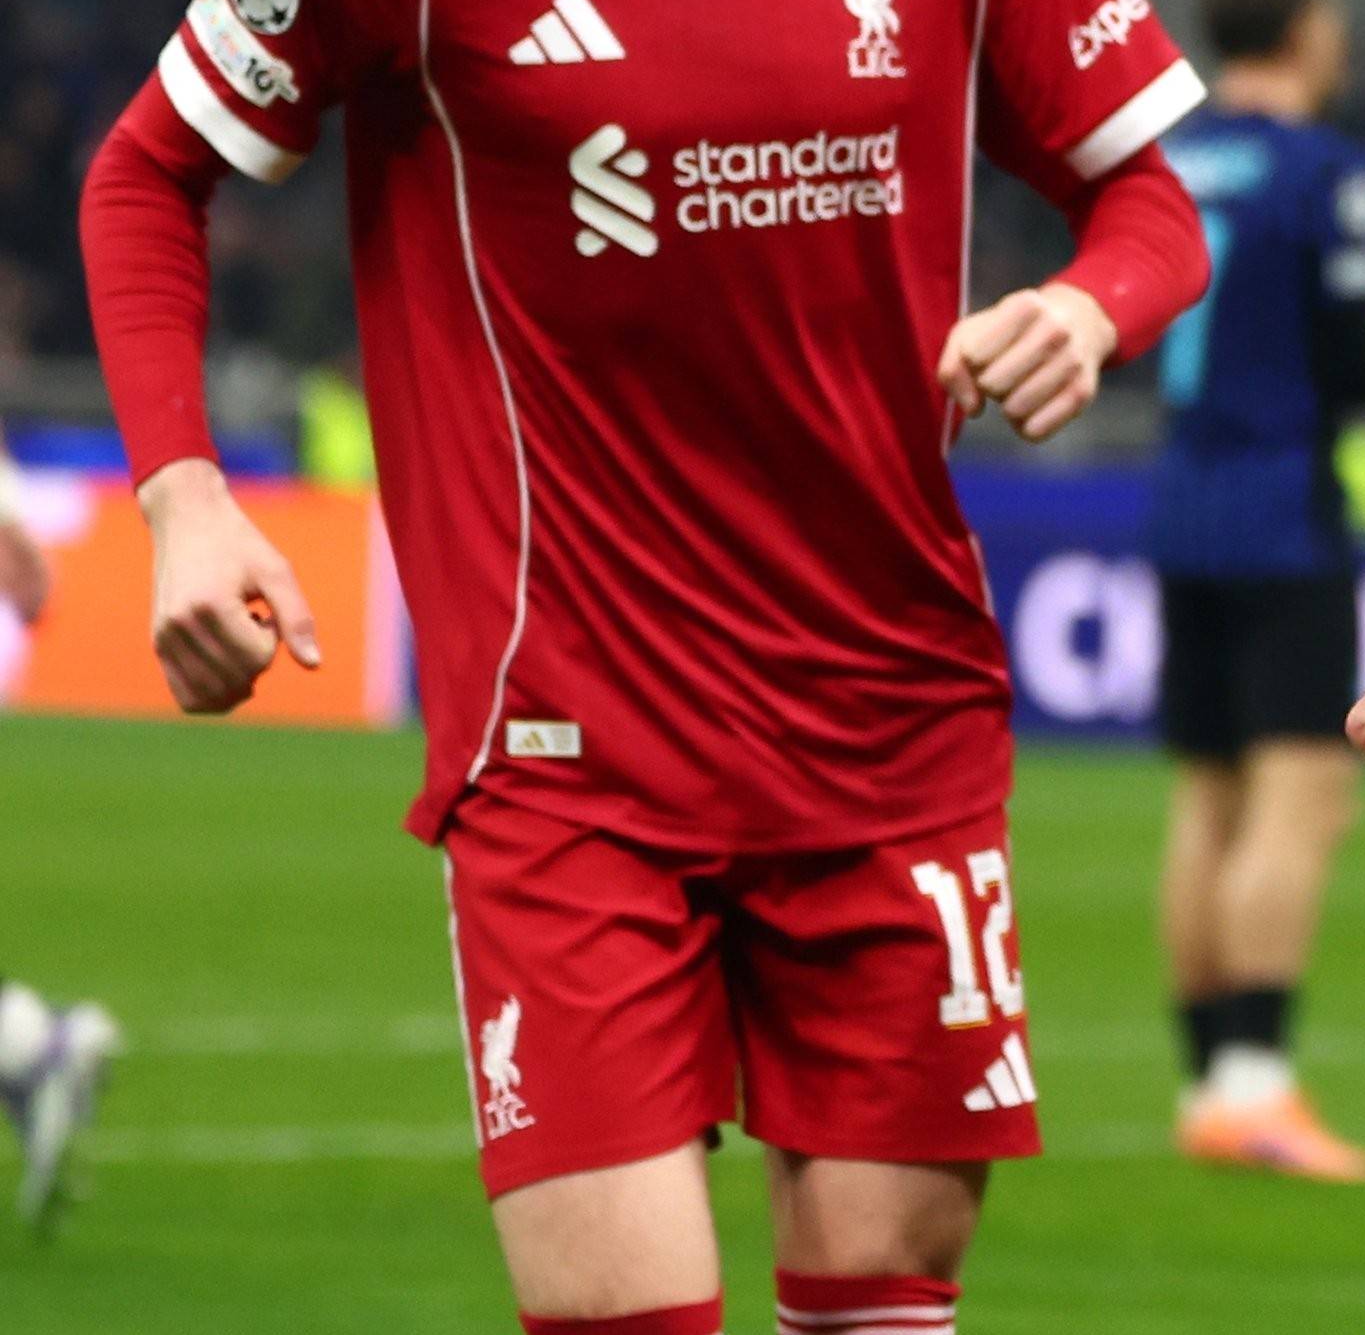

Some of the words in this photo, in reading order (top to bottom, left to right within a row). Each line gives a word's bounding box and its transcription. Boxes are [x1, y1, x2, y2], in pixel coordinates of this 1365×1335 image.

[673, 126, 898, 187] standard
[677, 171, 904, 233] chartered
[911, 848, 1027, 1030] 12
